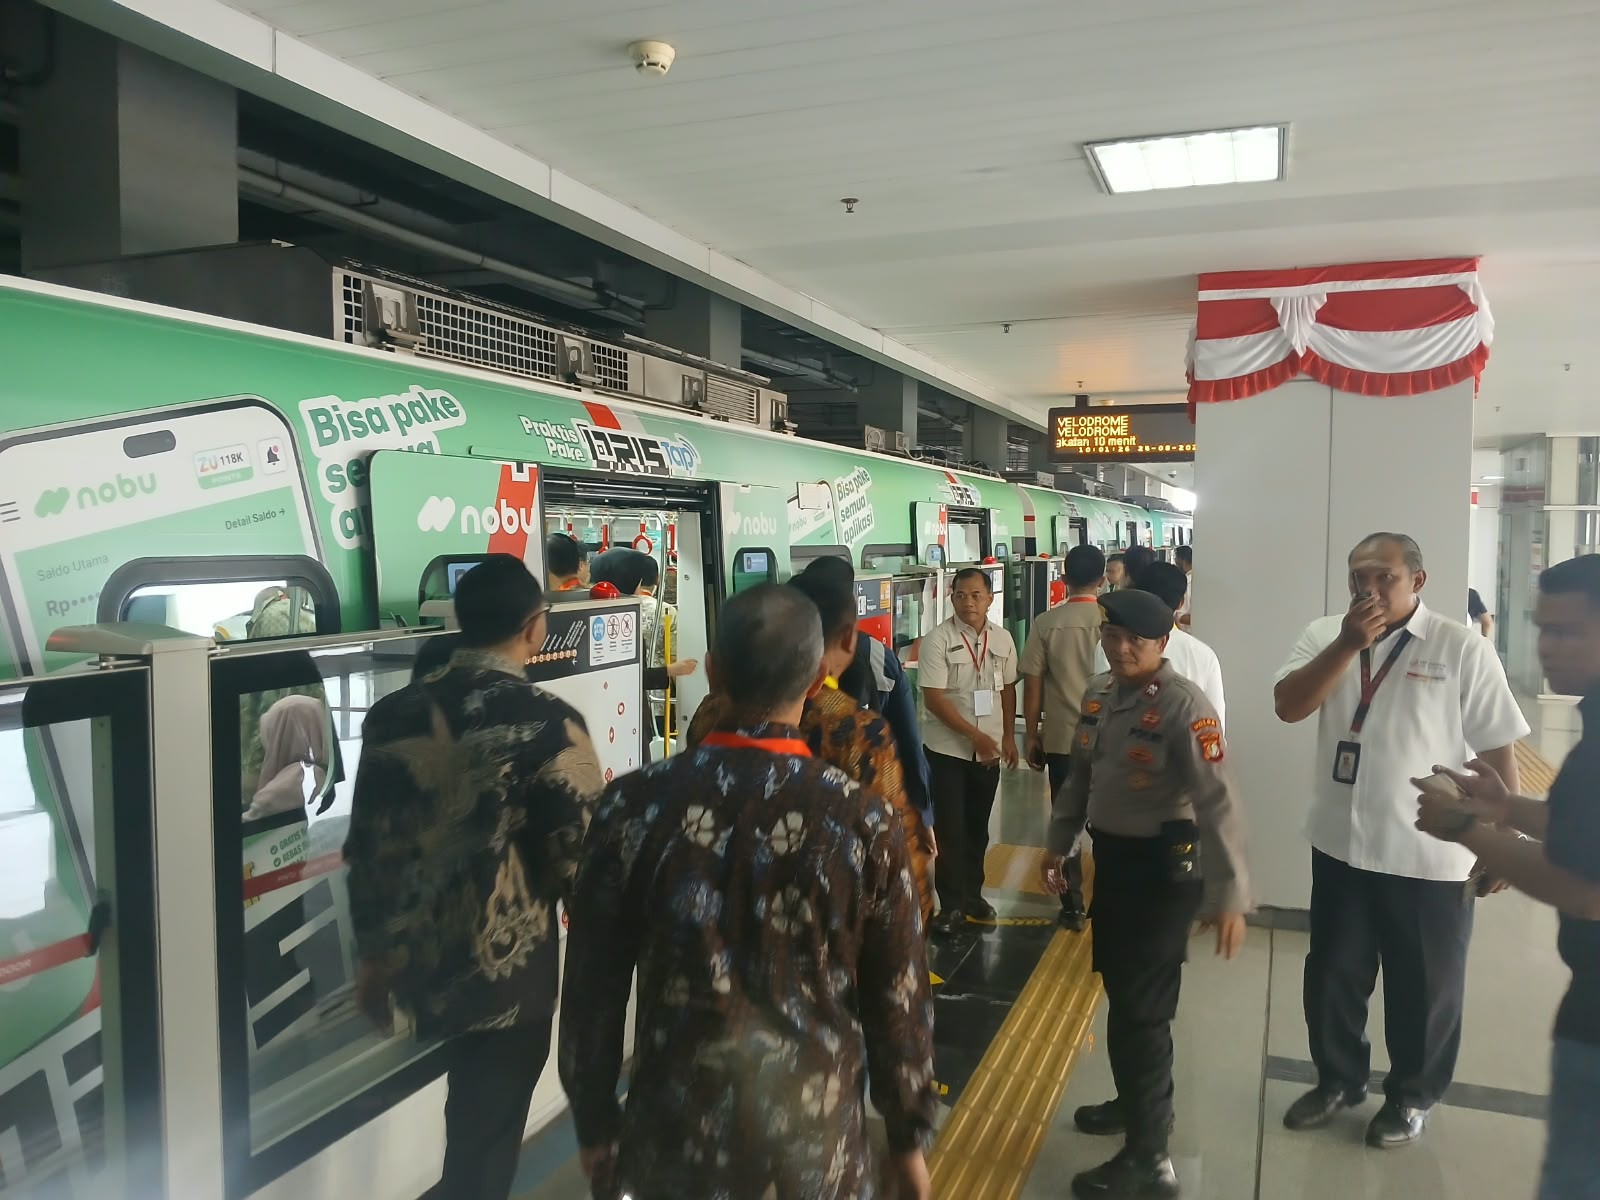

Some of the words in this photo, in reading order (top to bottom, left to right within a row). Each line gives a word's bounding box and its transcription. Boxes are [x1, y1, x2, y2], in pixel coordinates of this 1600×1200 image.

[308, 404, 390, 447] Bisa
[389, 391, 460, 436] pake
[519, 415, 579, 444] Praktis
[1057, 415, 1129, 427] VELODROME
[1057, 426, 1129, 437] VELODROME
[545, 438, 587, 462] Pake
[1094, 437, 1106, 446] 10
[1108, 435, 1137, 446] menit
[1137, 444, 1197, 452] 25-08-202
[220, 452, 244, 466] 118K
[661, 441, 693, 475] Tap
[77, 472, 157, 509] nobu
[836, 481, 854, 501] Bisa
[853, 469, 870, 491] pake
[225, 515, 251, 530] Detail
[252, 509, 277, 524] Saldo
[461, 499, 537, 534] nobu
[840, 495, 866, 523] semua
[744, 512, 777, 535] nobu
[843, 508, 873, 545] aplikasi
[37, 565, 70, 581] Saldo
[72, 555, 109, 571] Utama
[279, 830, 301, 850] GRATIS
